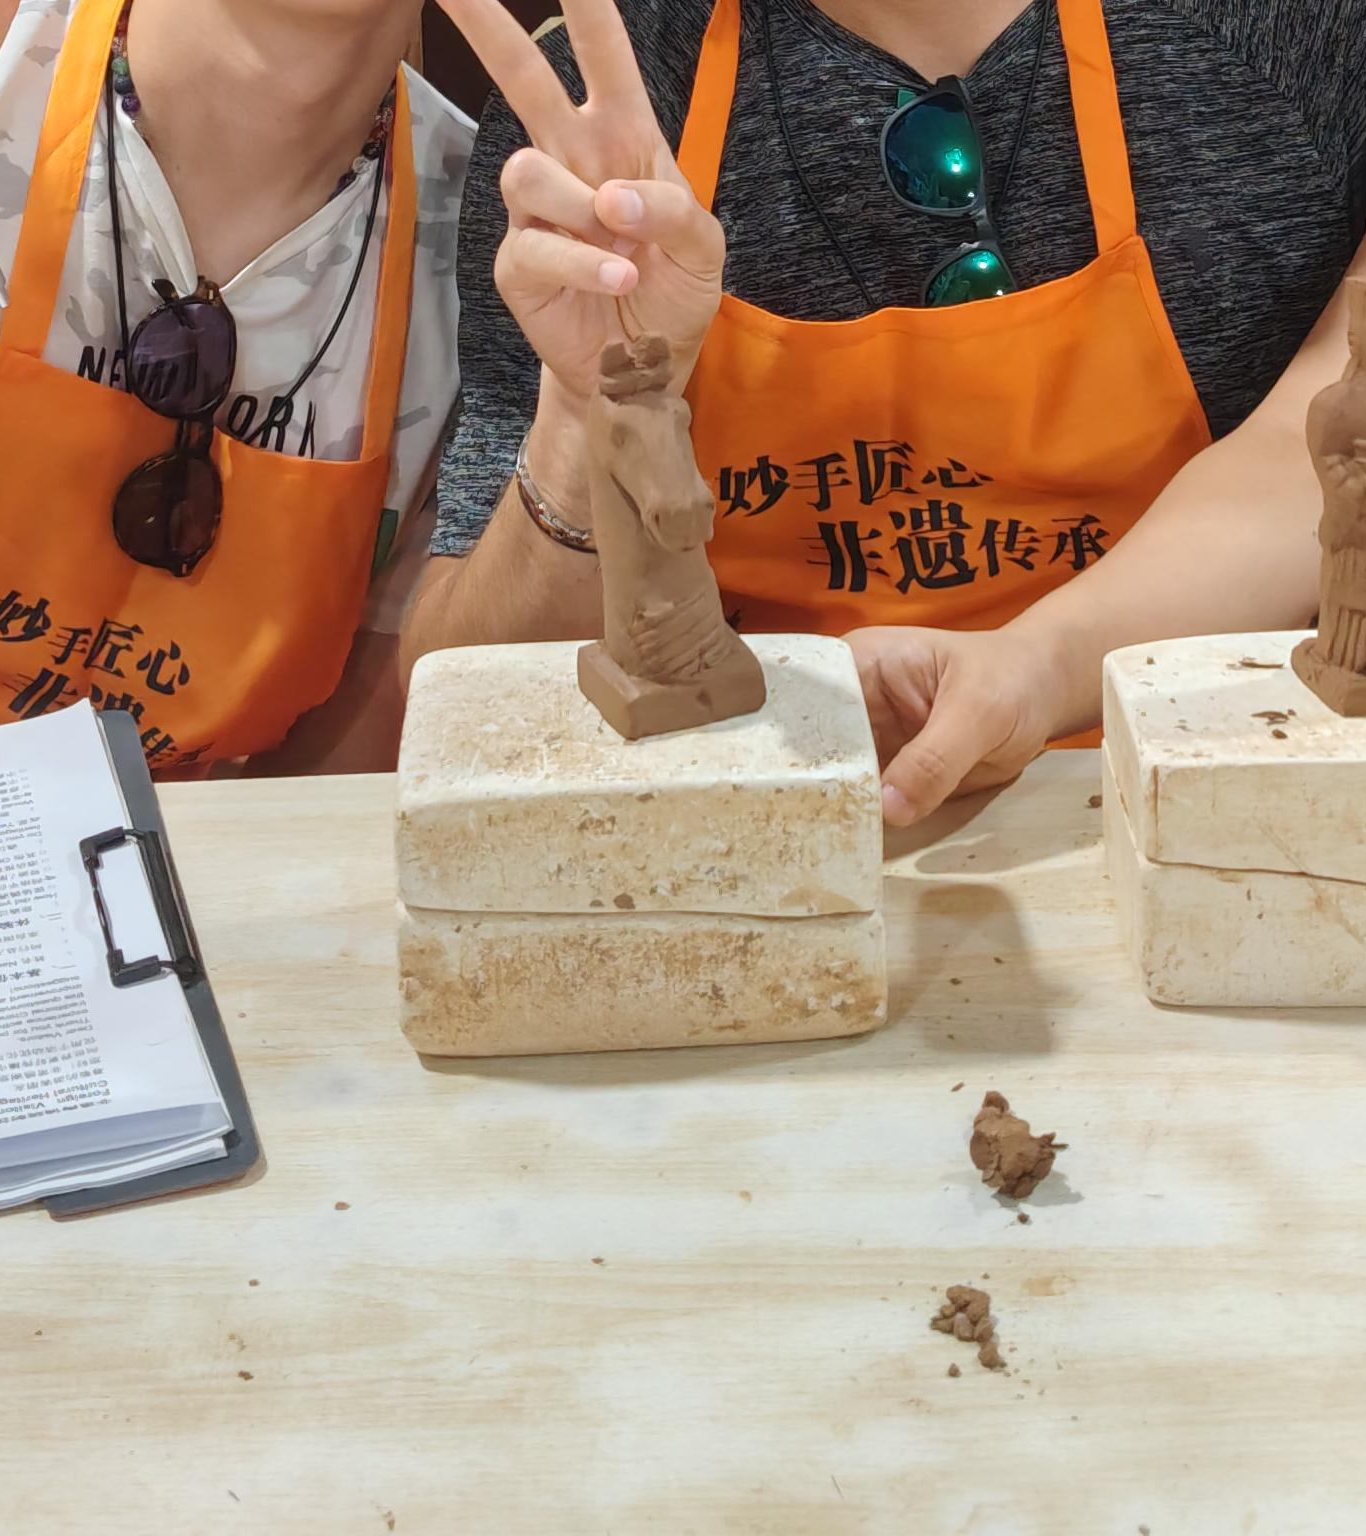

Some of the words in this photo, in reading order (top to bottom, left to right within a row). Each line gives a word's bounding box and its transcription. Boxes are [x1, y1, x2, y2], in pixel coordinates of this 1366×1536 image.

[716, 439, 995, 518] 妙手匠心
[797, 499, 1111, 595] 非遗传承
